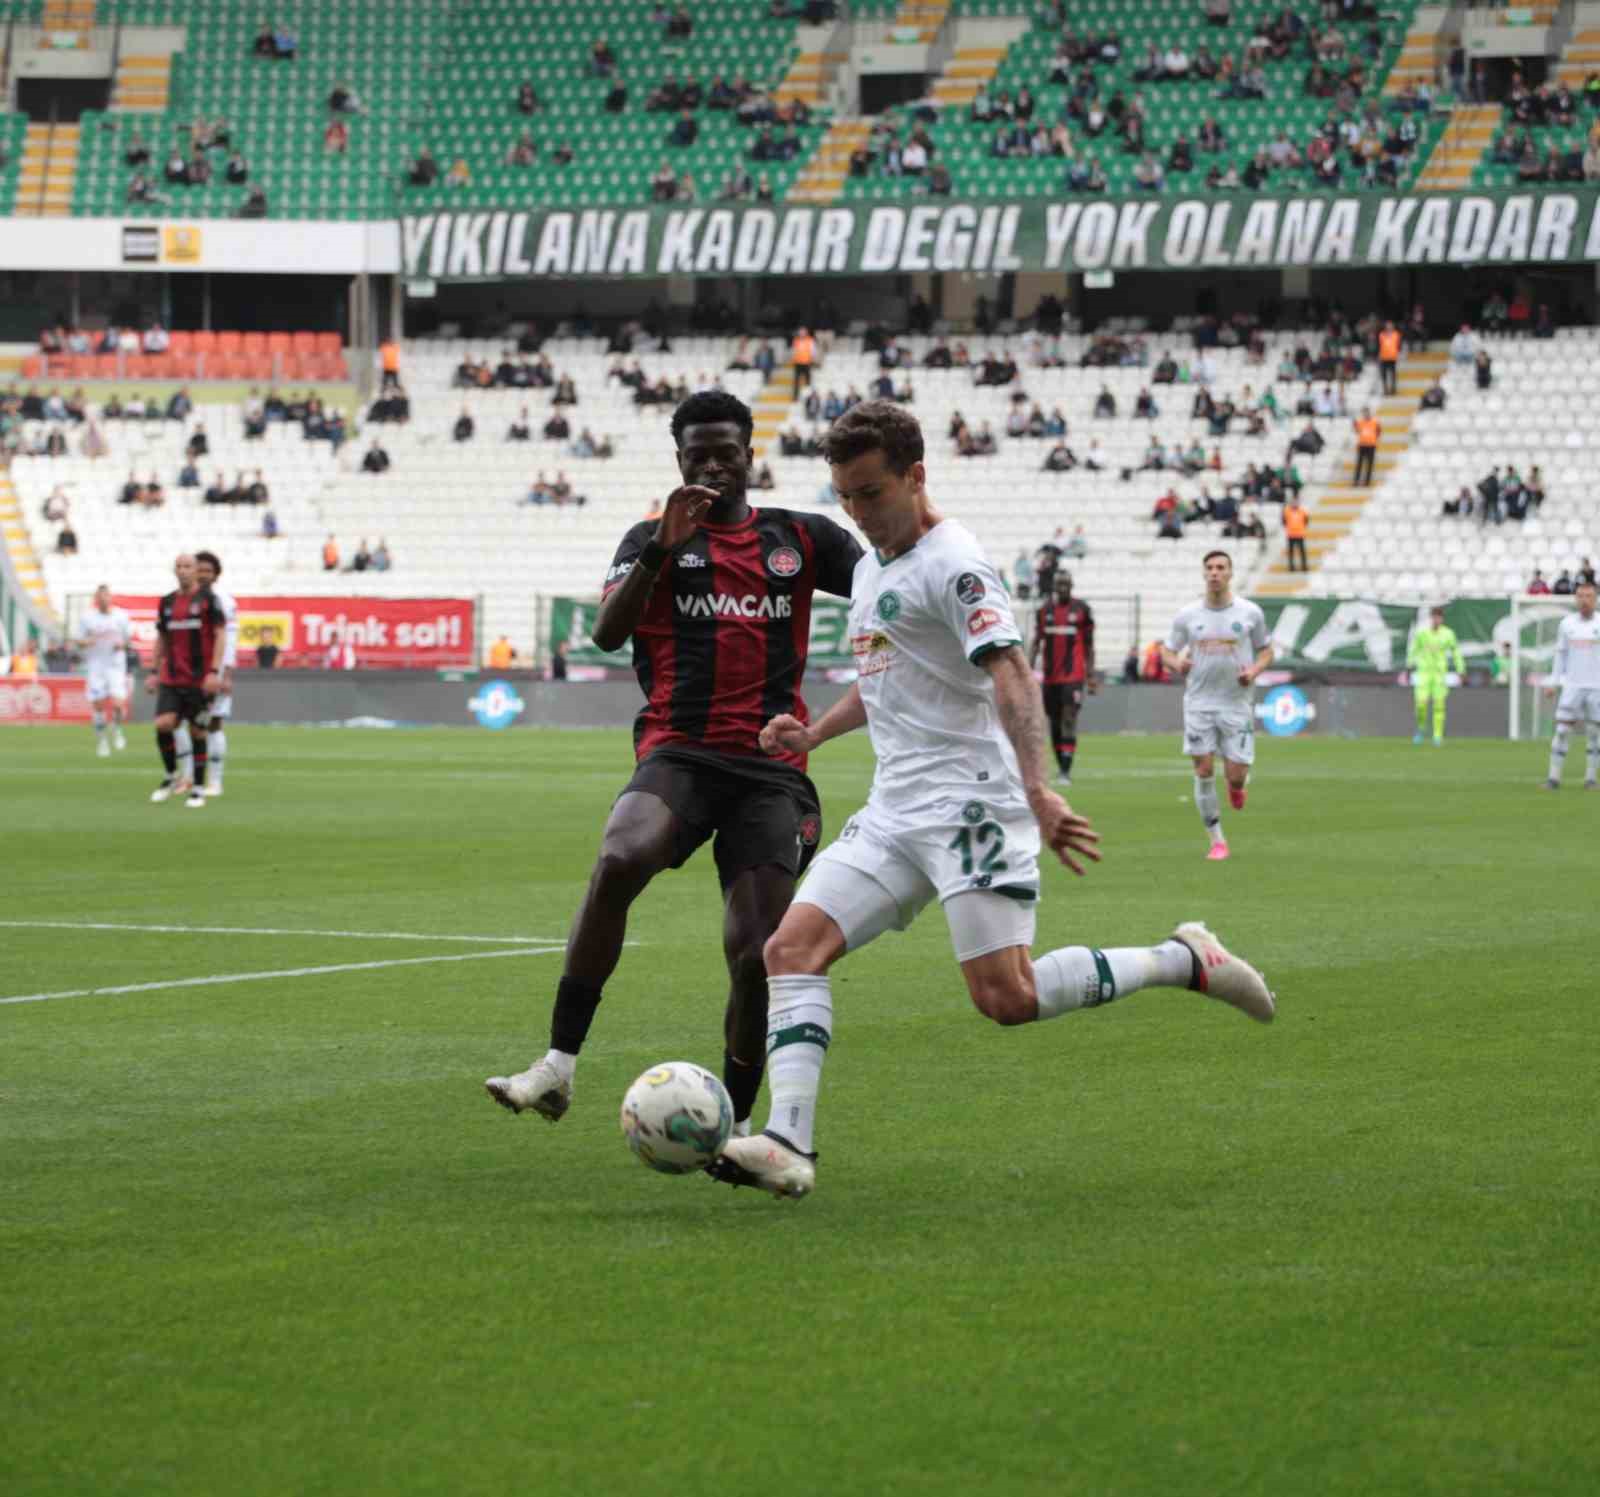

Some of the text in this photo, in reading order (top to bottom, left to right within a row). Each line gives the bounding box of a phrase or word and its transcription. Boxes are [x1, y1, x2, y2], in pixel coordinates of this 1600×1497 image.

[402, 210, 649, 277] YIKILANA
[656, 206, 855, 273] KADAR
[1043, 201, 1160, 270] YOK
[1163, 199, 1360, 267] OLANA
[1367, 194, 1579, 265] KADAR
[675, 593, 793, 619] VAVACARS
[302, 614, 389, 647] Trink
[395, 613, 462, 648] sat!
[948, 821, 1008, 875] 12
